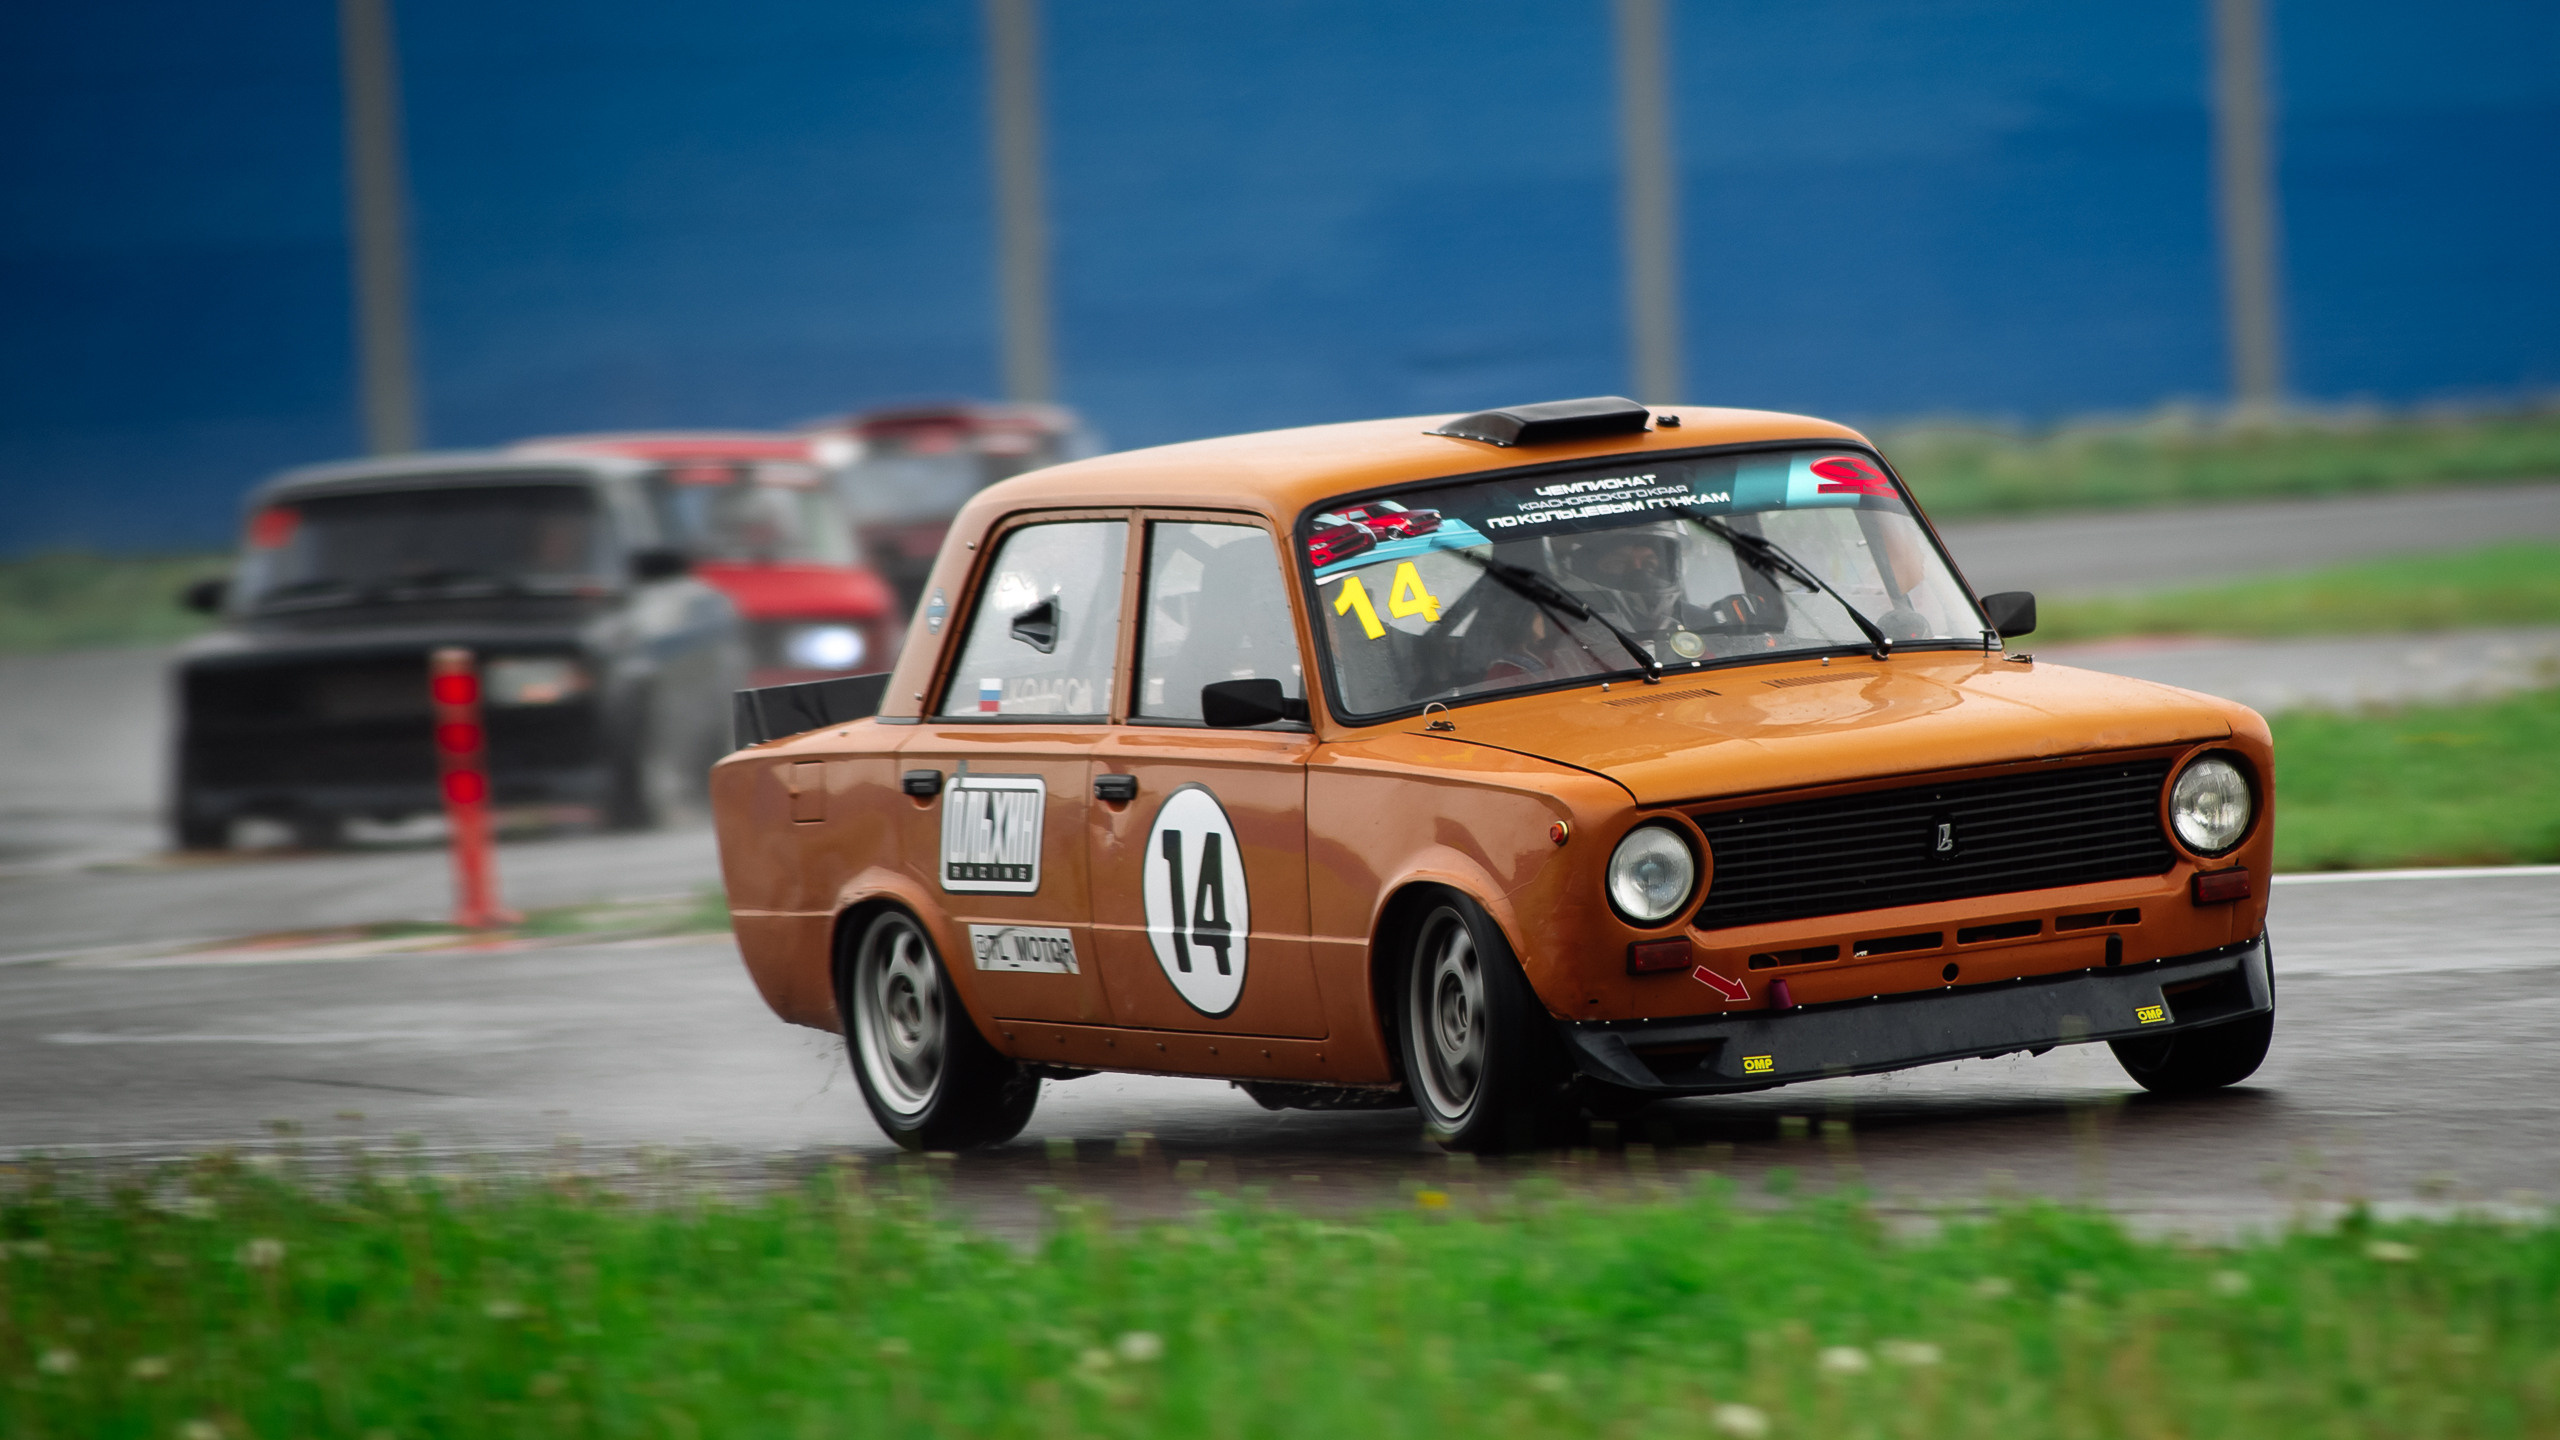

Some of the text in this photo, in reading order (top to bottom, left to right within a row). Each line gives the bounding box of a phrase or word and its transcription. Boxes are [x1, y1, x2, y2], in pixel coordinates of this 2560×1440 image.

[1535, 474, 1656, 496] ЧЕМПИОНАТ
[1517, 485, 1689, 512] КРАСНОЯРСКОГО КРАЯ
[1486, 515, 1518, 529] ПО
[1516, 500, 1645, 525] КОЛЬЦЕВЫМ
[1333, 561, 1441, 640] 14
[952, 865, 1027, 880] RACING
[1163, 829, 1231, 976] 14
[2137, 1008, 2163, 1021] OMP
[1743, 1058, 1773, 1070] OMP
